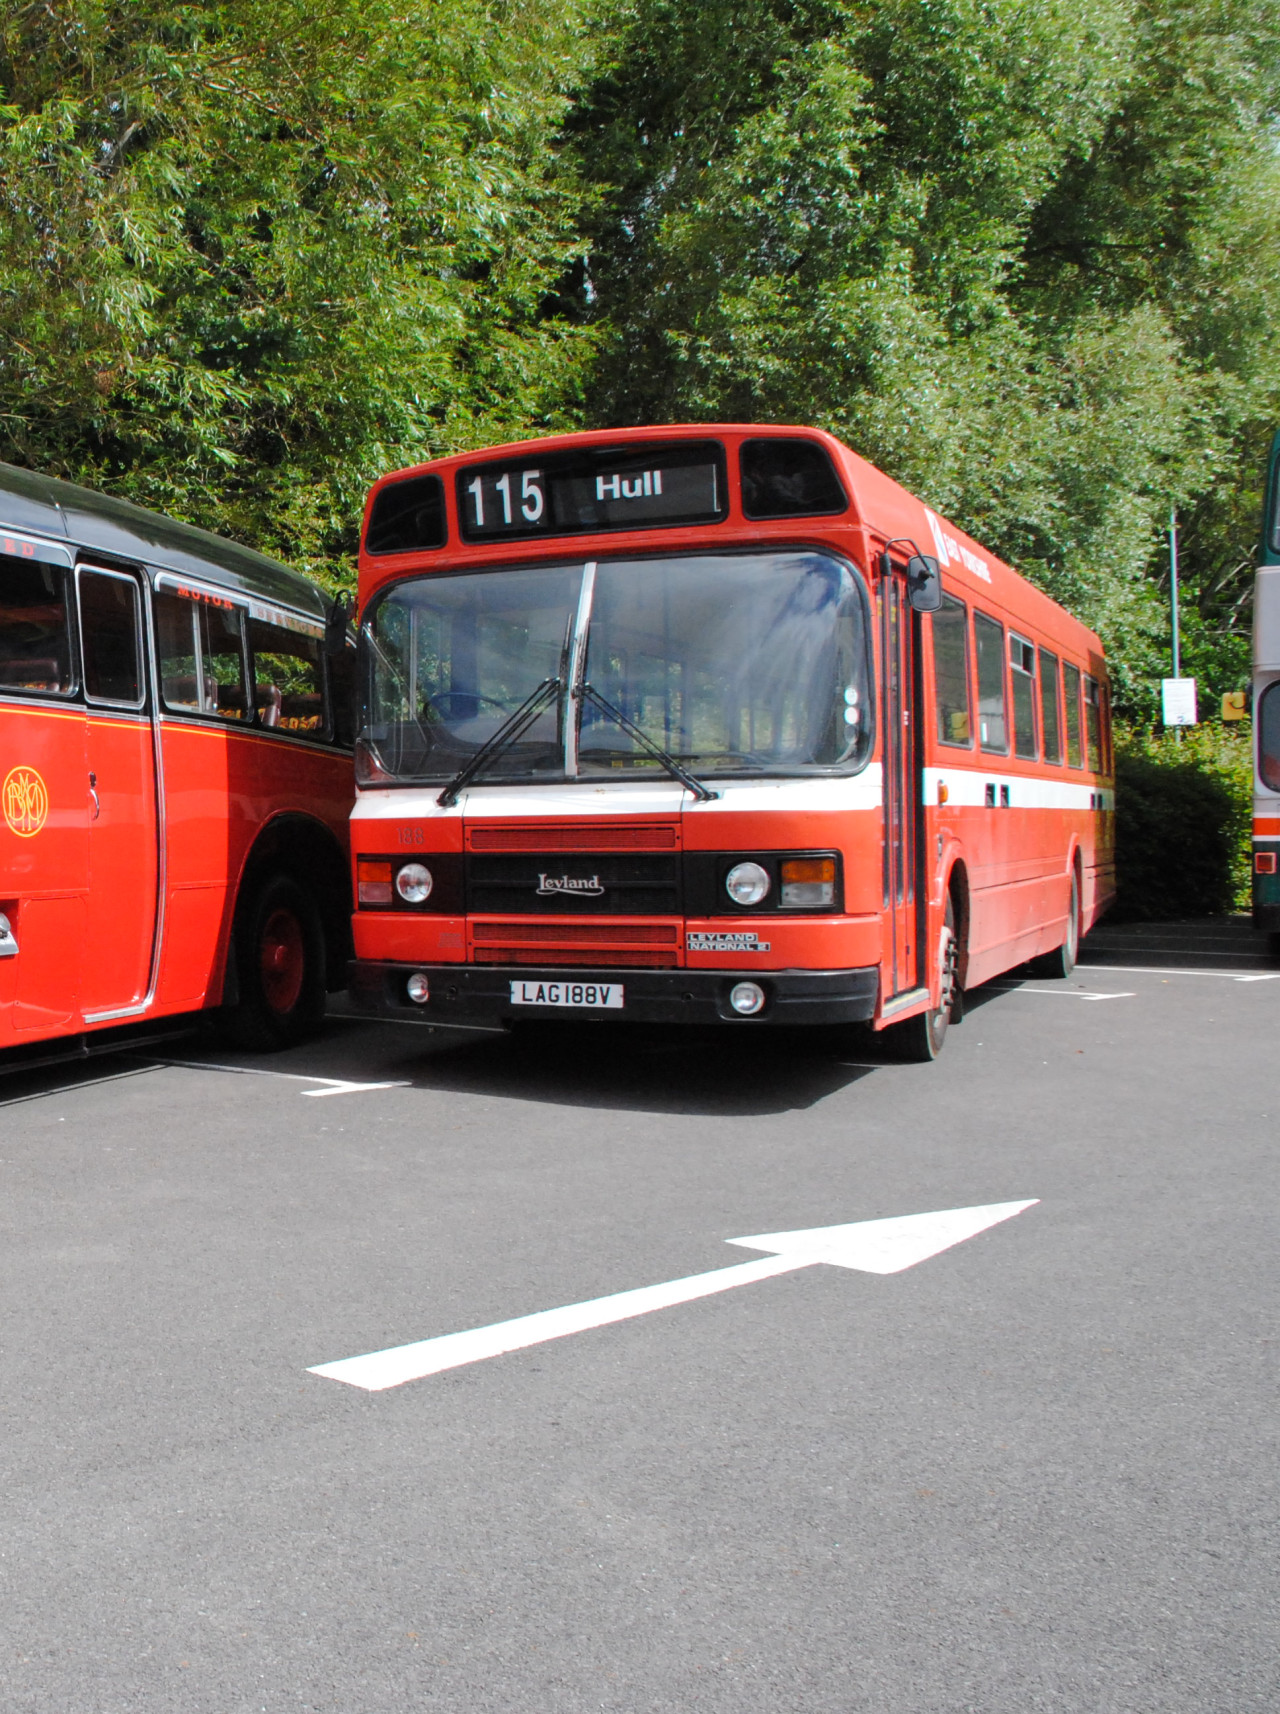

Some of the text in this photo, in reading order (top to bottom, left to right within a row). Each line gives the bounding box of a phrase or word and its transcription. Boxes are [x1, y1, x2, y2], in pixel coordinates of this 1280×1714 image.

[468, 469, 662, 526] 115 Hull
[177, 583, 235, 610] MOTOR
[397, 827, 424, 844] 188
[536, 873, 605, 896] Leyland
[689, 933, 756, 941] LEYLAND
[690, 942, 767, 951] NATIONAL 2
